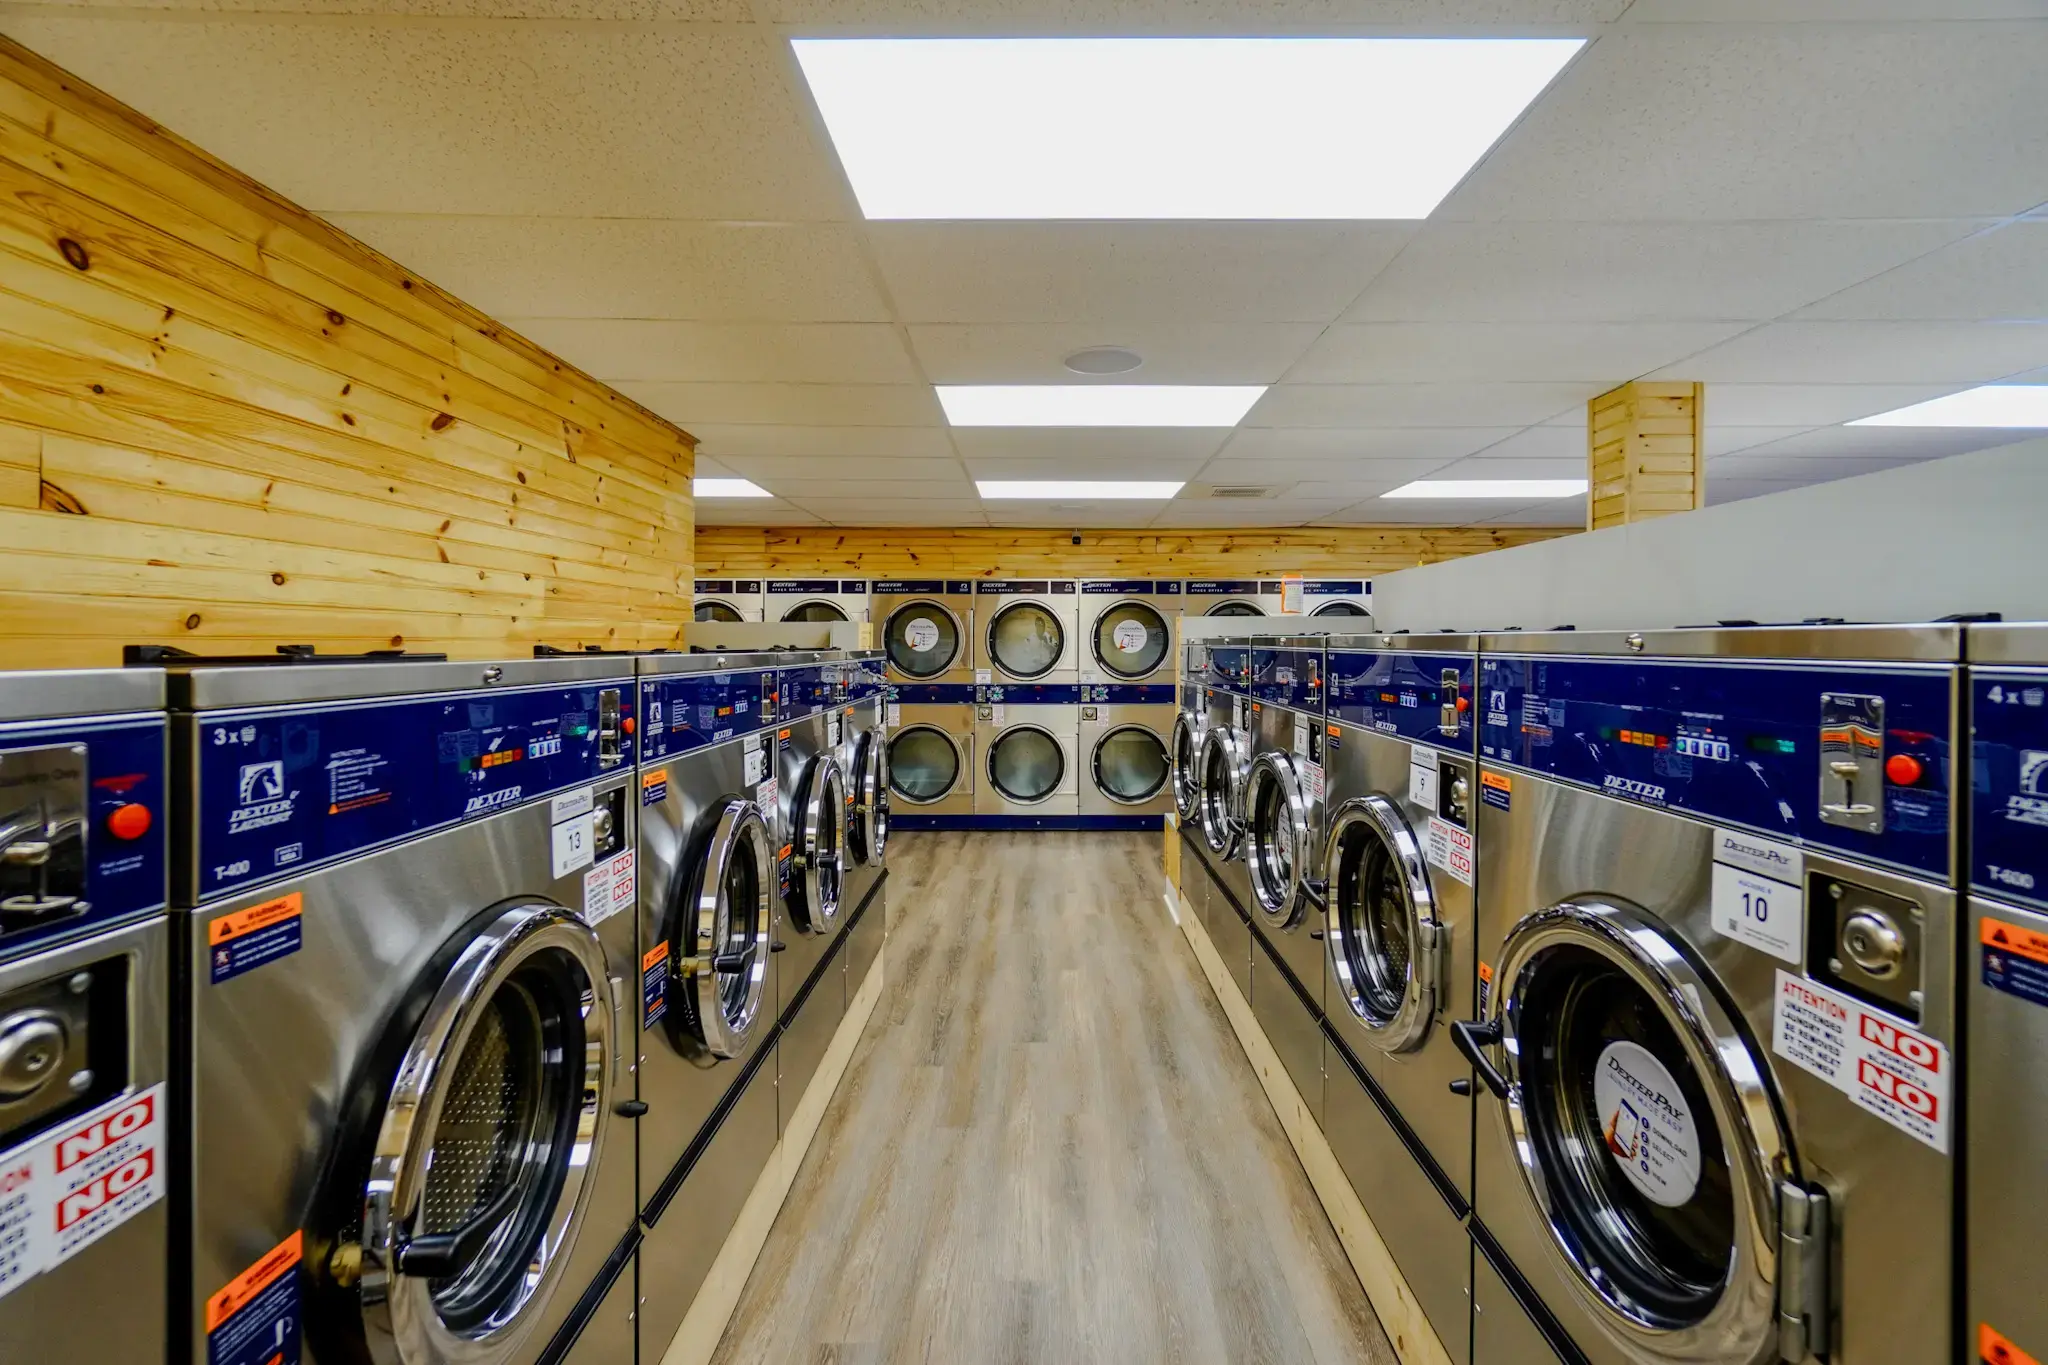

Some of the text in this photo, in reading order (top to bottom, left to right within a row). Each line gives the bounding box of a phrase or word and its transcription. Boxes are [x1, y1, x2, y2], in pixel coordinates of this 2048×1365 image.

[1376, 720, 1397, 732] DEXTER
[1420, 778, 1425, 791] 9
[1604, 775, 1665, 799] DEXTER
[229, 800, 292, 822] DEXTER
[465, 786, 522, 813] DEXTER
[228, 810, 293, 834] LAUNDRY
[569, 831, 581, 852] 13
[1452, 830, 1469, 847] NO
[214, 860, 250, 880] T-400
[615, 856, 632, 874] NO
[1452, 854, 1469, 871] NO
[615, 880, 632, 899] NO
[1742, 892, 1767, 922] 10
[1783, 980, 1847, 1022] ATTENTION
[1781, 1010, 1846, 1048] LAUNDRY WILL
[1784, 1000, 1843, 1034] UNATTENDED
[1783, 1033, 1841, 1068] BY THE NEXT
[1785, 1022, 1841, 1056] BE REMOVED
[1864, 1018, 1934, 1066] NO
[1787, 1046, 1835, 1077] CUSTOMER
[1862, 1064, 1932, 1114] NO
[62, 1104, 149, 1169] NO
[1652, 1127, 1688, 1158] DOWNLOAD
[1652, 1142, 1674, 1163] SELECT
[62, 1157, 149, 1226] NO
